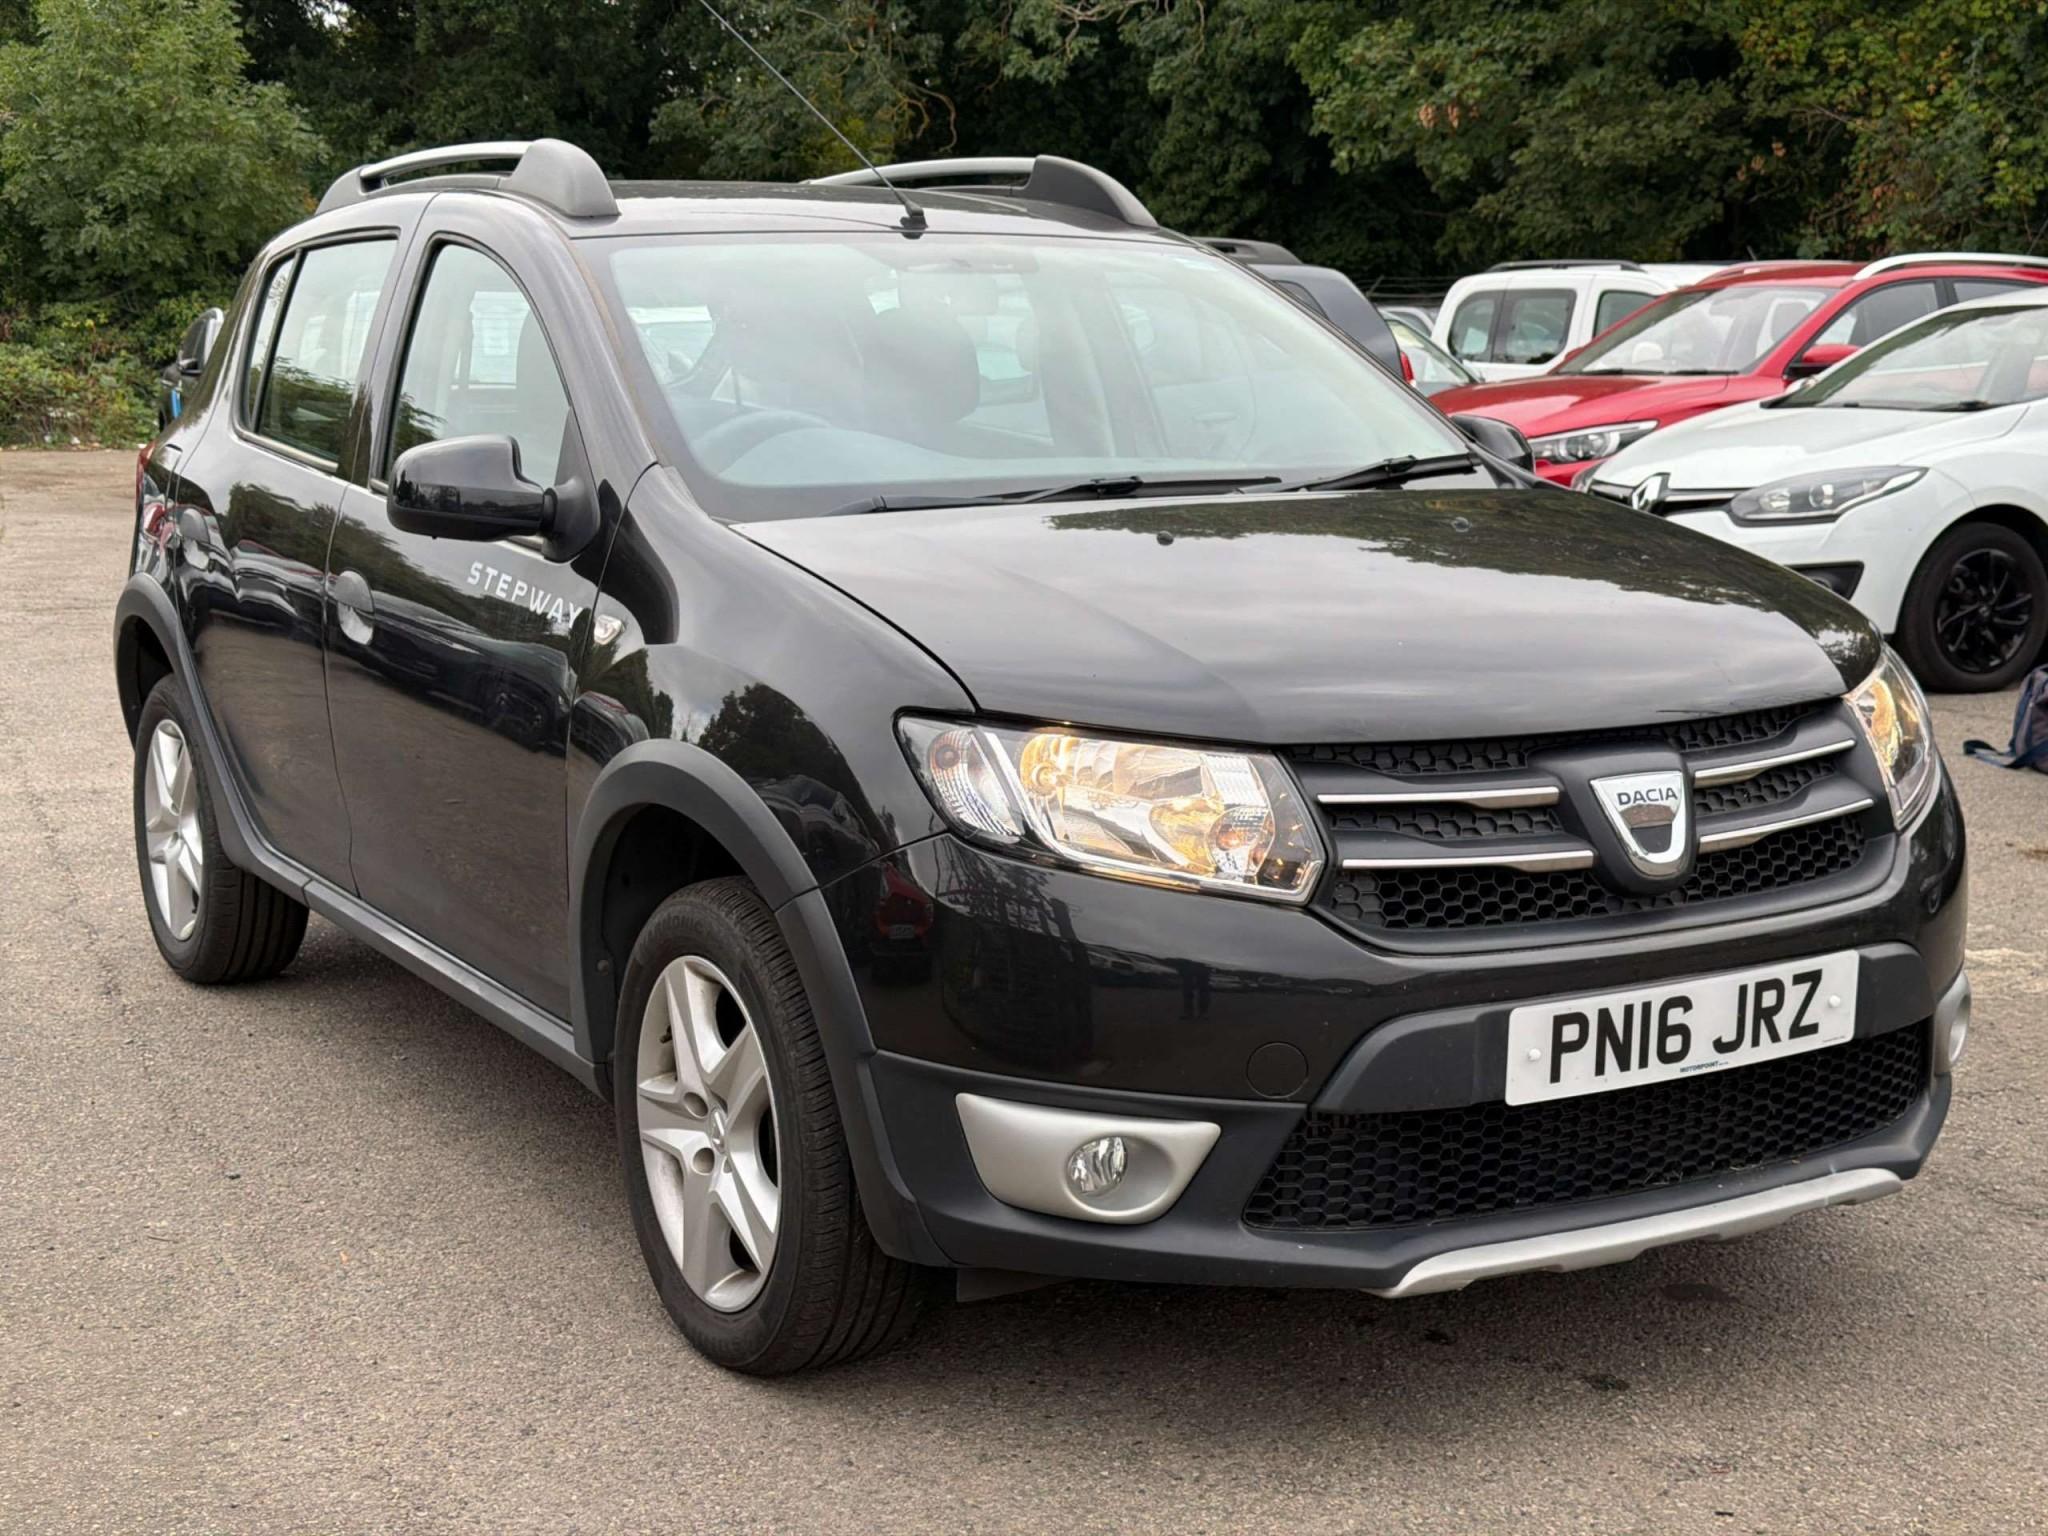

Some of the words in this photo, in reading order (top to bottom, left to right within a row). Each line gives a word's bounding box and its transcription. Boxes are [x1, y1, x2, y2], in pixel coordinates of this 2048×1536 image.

[467, 561, 583, 629] STEPWAY
[1616, 787, 1678, 806] DACIA
[1549, 995, 1693, 1084] PN16
[1712, 968, 1823, 1055] JRZ
